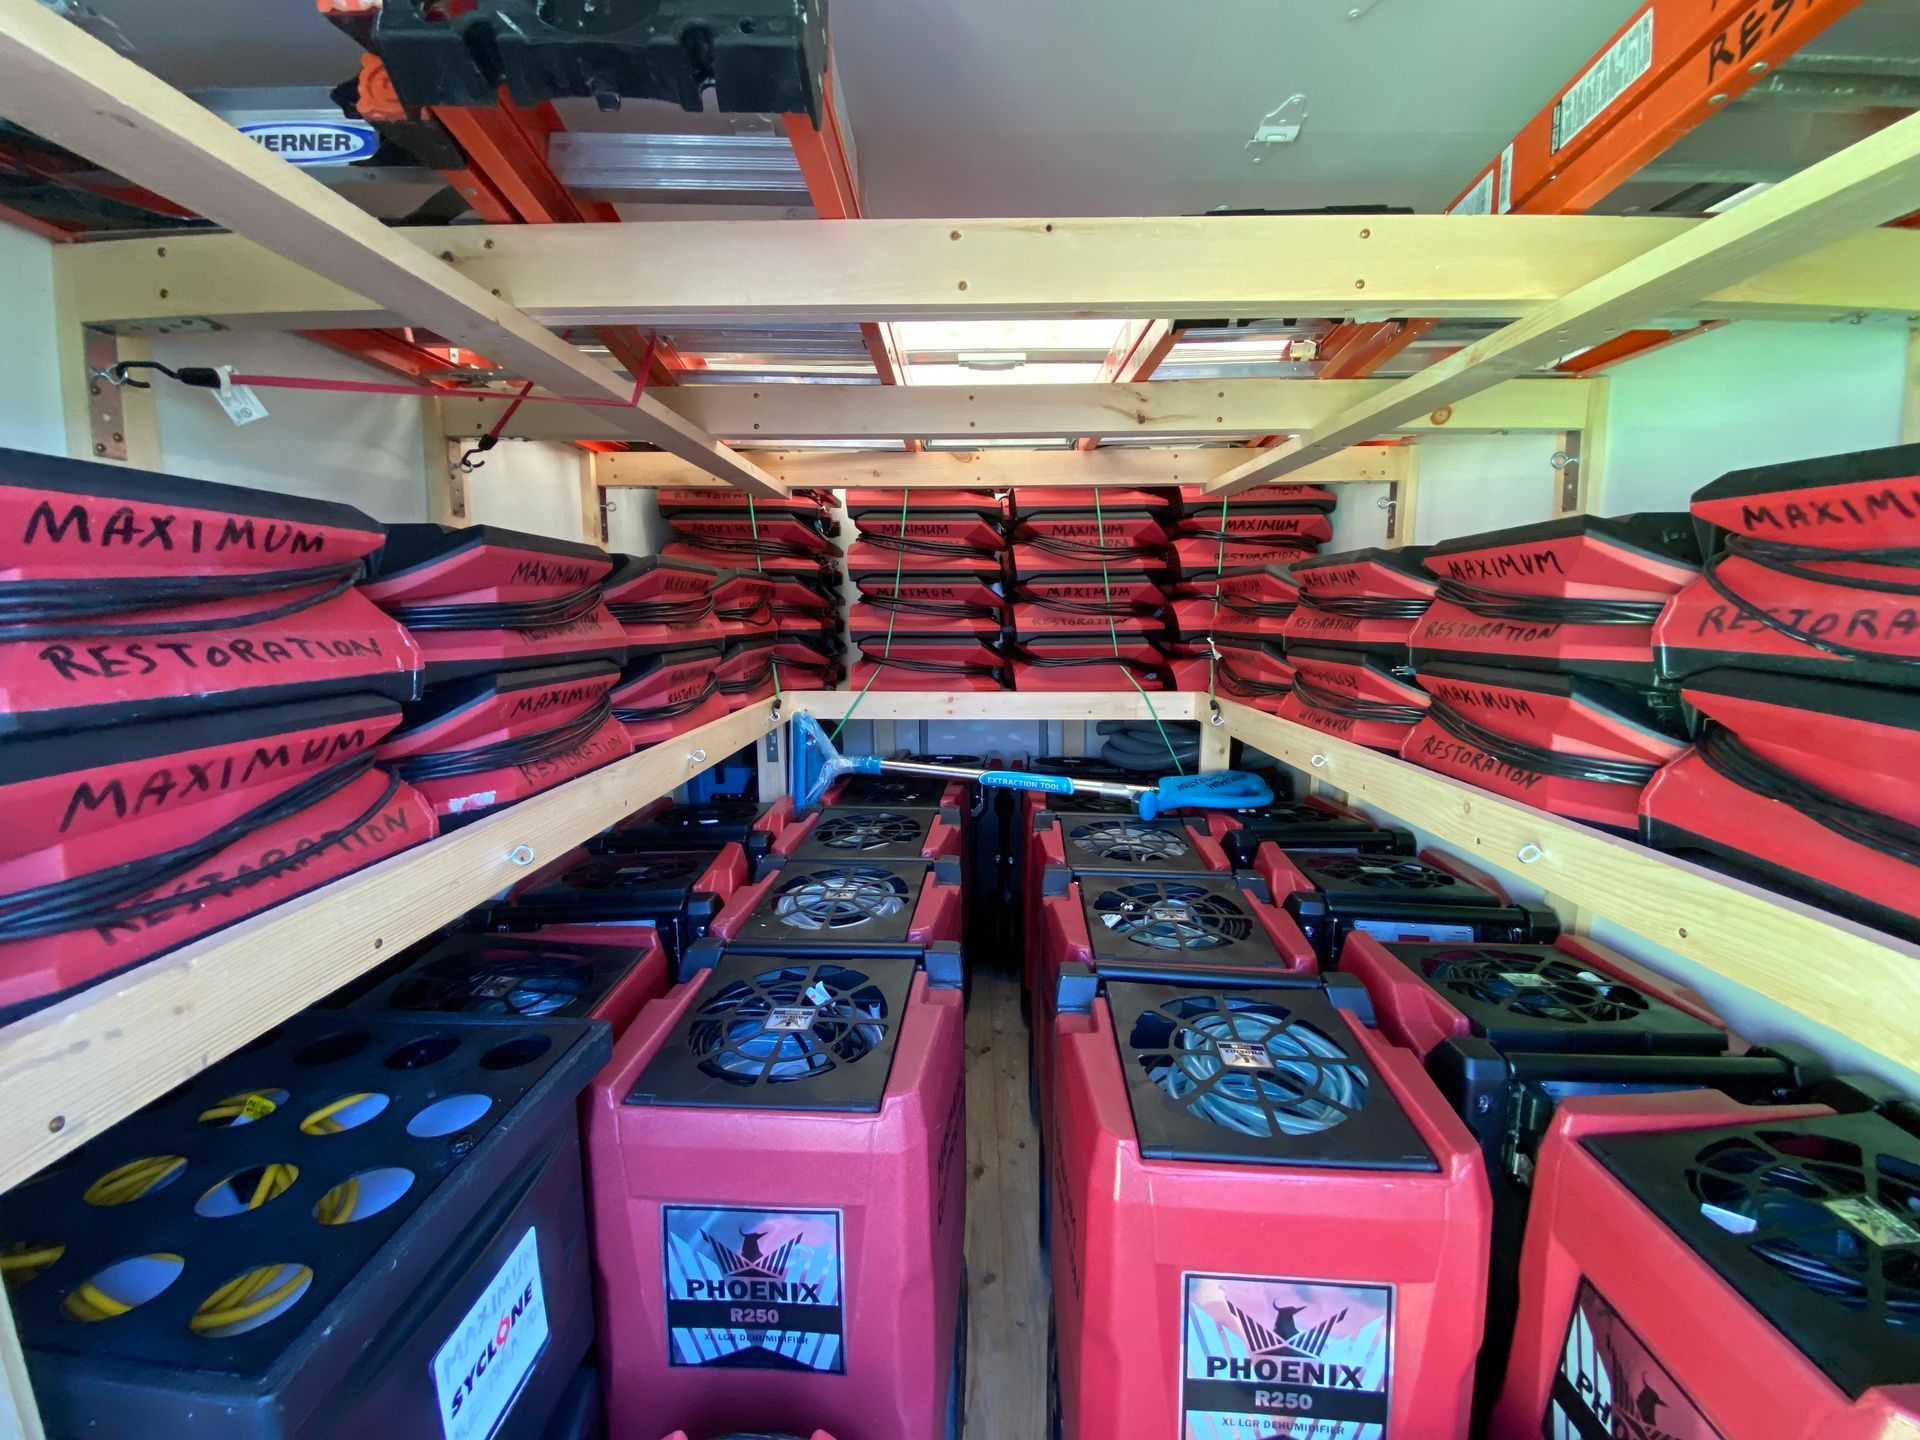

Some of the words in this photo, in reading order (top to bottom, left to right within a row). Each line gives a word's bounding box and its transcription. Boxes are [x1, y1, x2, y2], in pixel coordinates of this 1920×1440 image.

[1708, 0, 1814, 86] RES
[24, 501, 325, 553] MAXIMUM
[881, 524, 949, 535] MAXIMUM
[1052, 525, 1124, 537] MAXIMUM
[1225, 519, 1299, 532] MAXIMUM
[510, 561, 590, 585] MAXIMUM
[1447, 550, 1564, 579] MAXIMUM
[1046, 587, 1130, 597] MAXIMUM
[1425, 620, 1560, 641] RESTORATION
[39, 638, 382, 681] RESTORATION
[510, 682, 607, 718] MAXIMUM
[1437, 684, 1535, 718] MAXIMUM
[1421, 735, 1542, 789] RESTORATION
[59, 729, 365, 832] MAXIMUM
[987, 777, 1037, 788] EXTRACTION
[1039, 782, 1061, 791] TOOL
[686, 1279, 821, 1303] PHOENIX
[730, 1308, 779, 1324] R250
[451, 1279, 534, 1419] SYCLONE
[740, 1334, 808, 1344] DEHUMIDIFIER
[1206, 1356, 1363, 1388] PHOENIX
[1255, 1390, 1313, 1410] R250
[1222, 1417, 1235, 1426] XL
[1238, 1418, 1259, 1428] LGR
[1263, 1419, 1345, 1435] DEHUMIDIFIER
